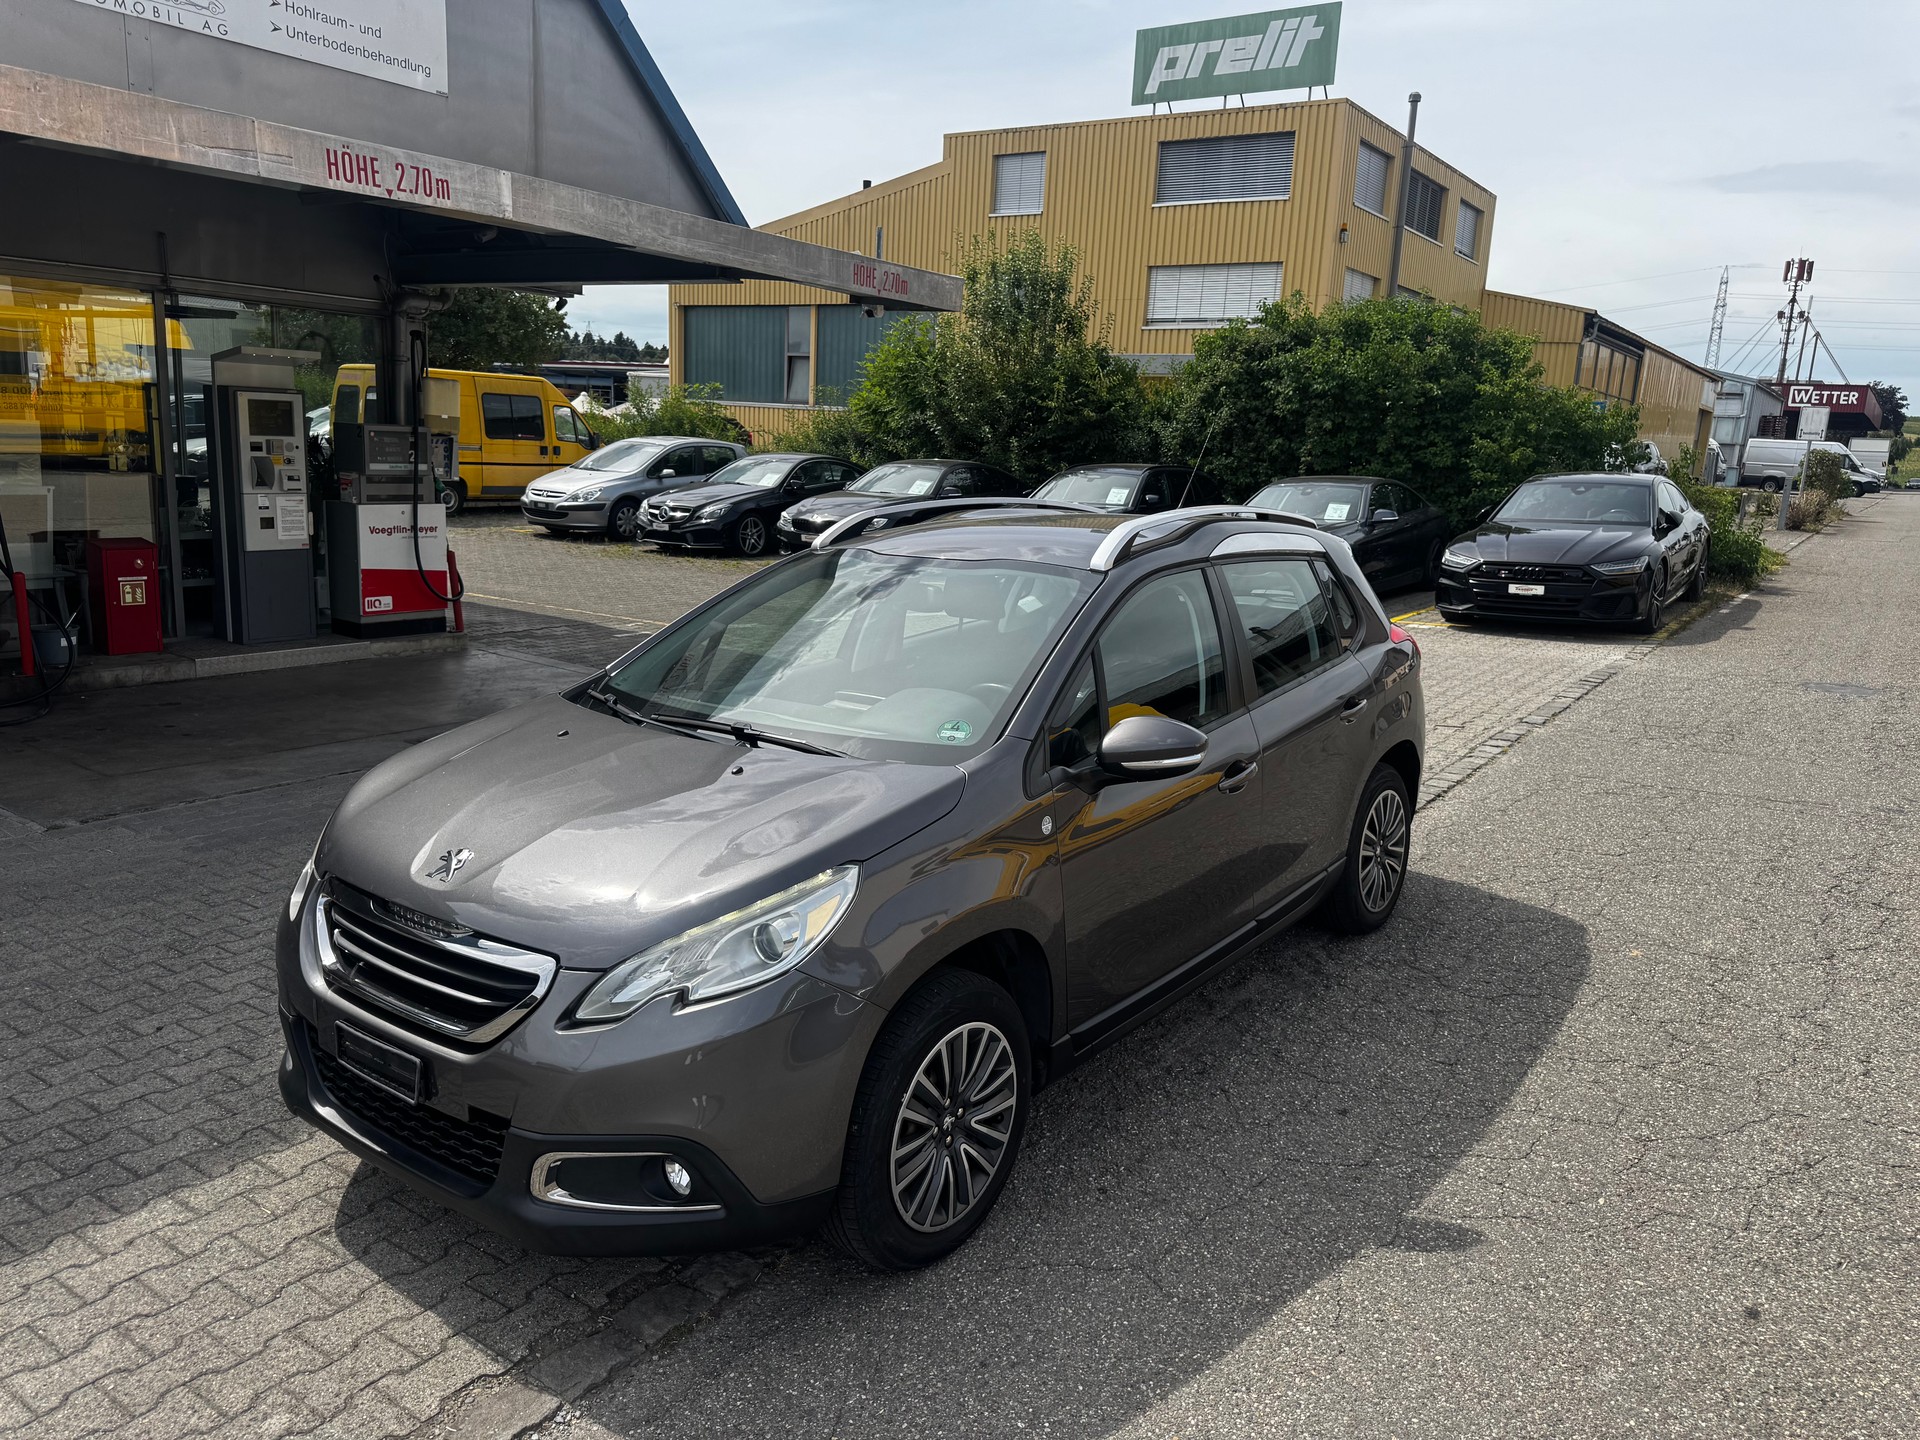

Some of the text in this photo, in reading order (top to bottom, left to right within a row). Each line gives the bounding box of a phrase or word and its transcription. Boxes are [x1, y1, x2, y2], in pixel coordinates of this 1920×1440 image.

[202, 20, 229, 36] AG
[285, 0, 382, 39] Hohlraum- und
[285, 24, 432, 78] Unterbodenbehandlung
[1144, 15, 1325, 95] prelit
[326, 144, 382, 188] HÖHE
[853, 260, 877, 289] HÖHE
[1792, 387, 1859, 405] WETTER
[950, 720, 961, 732] 4
